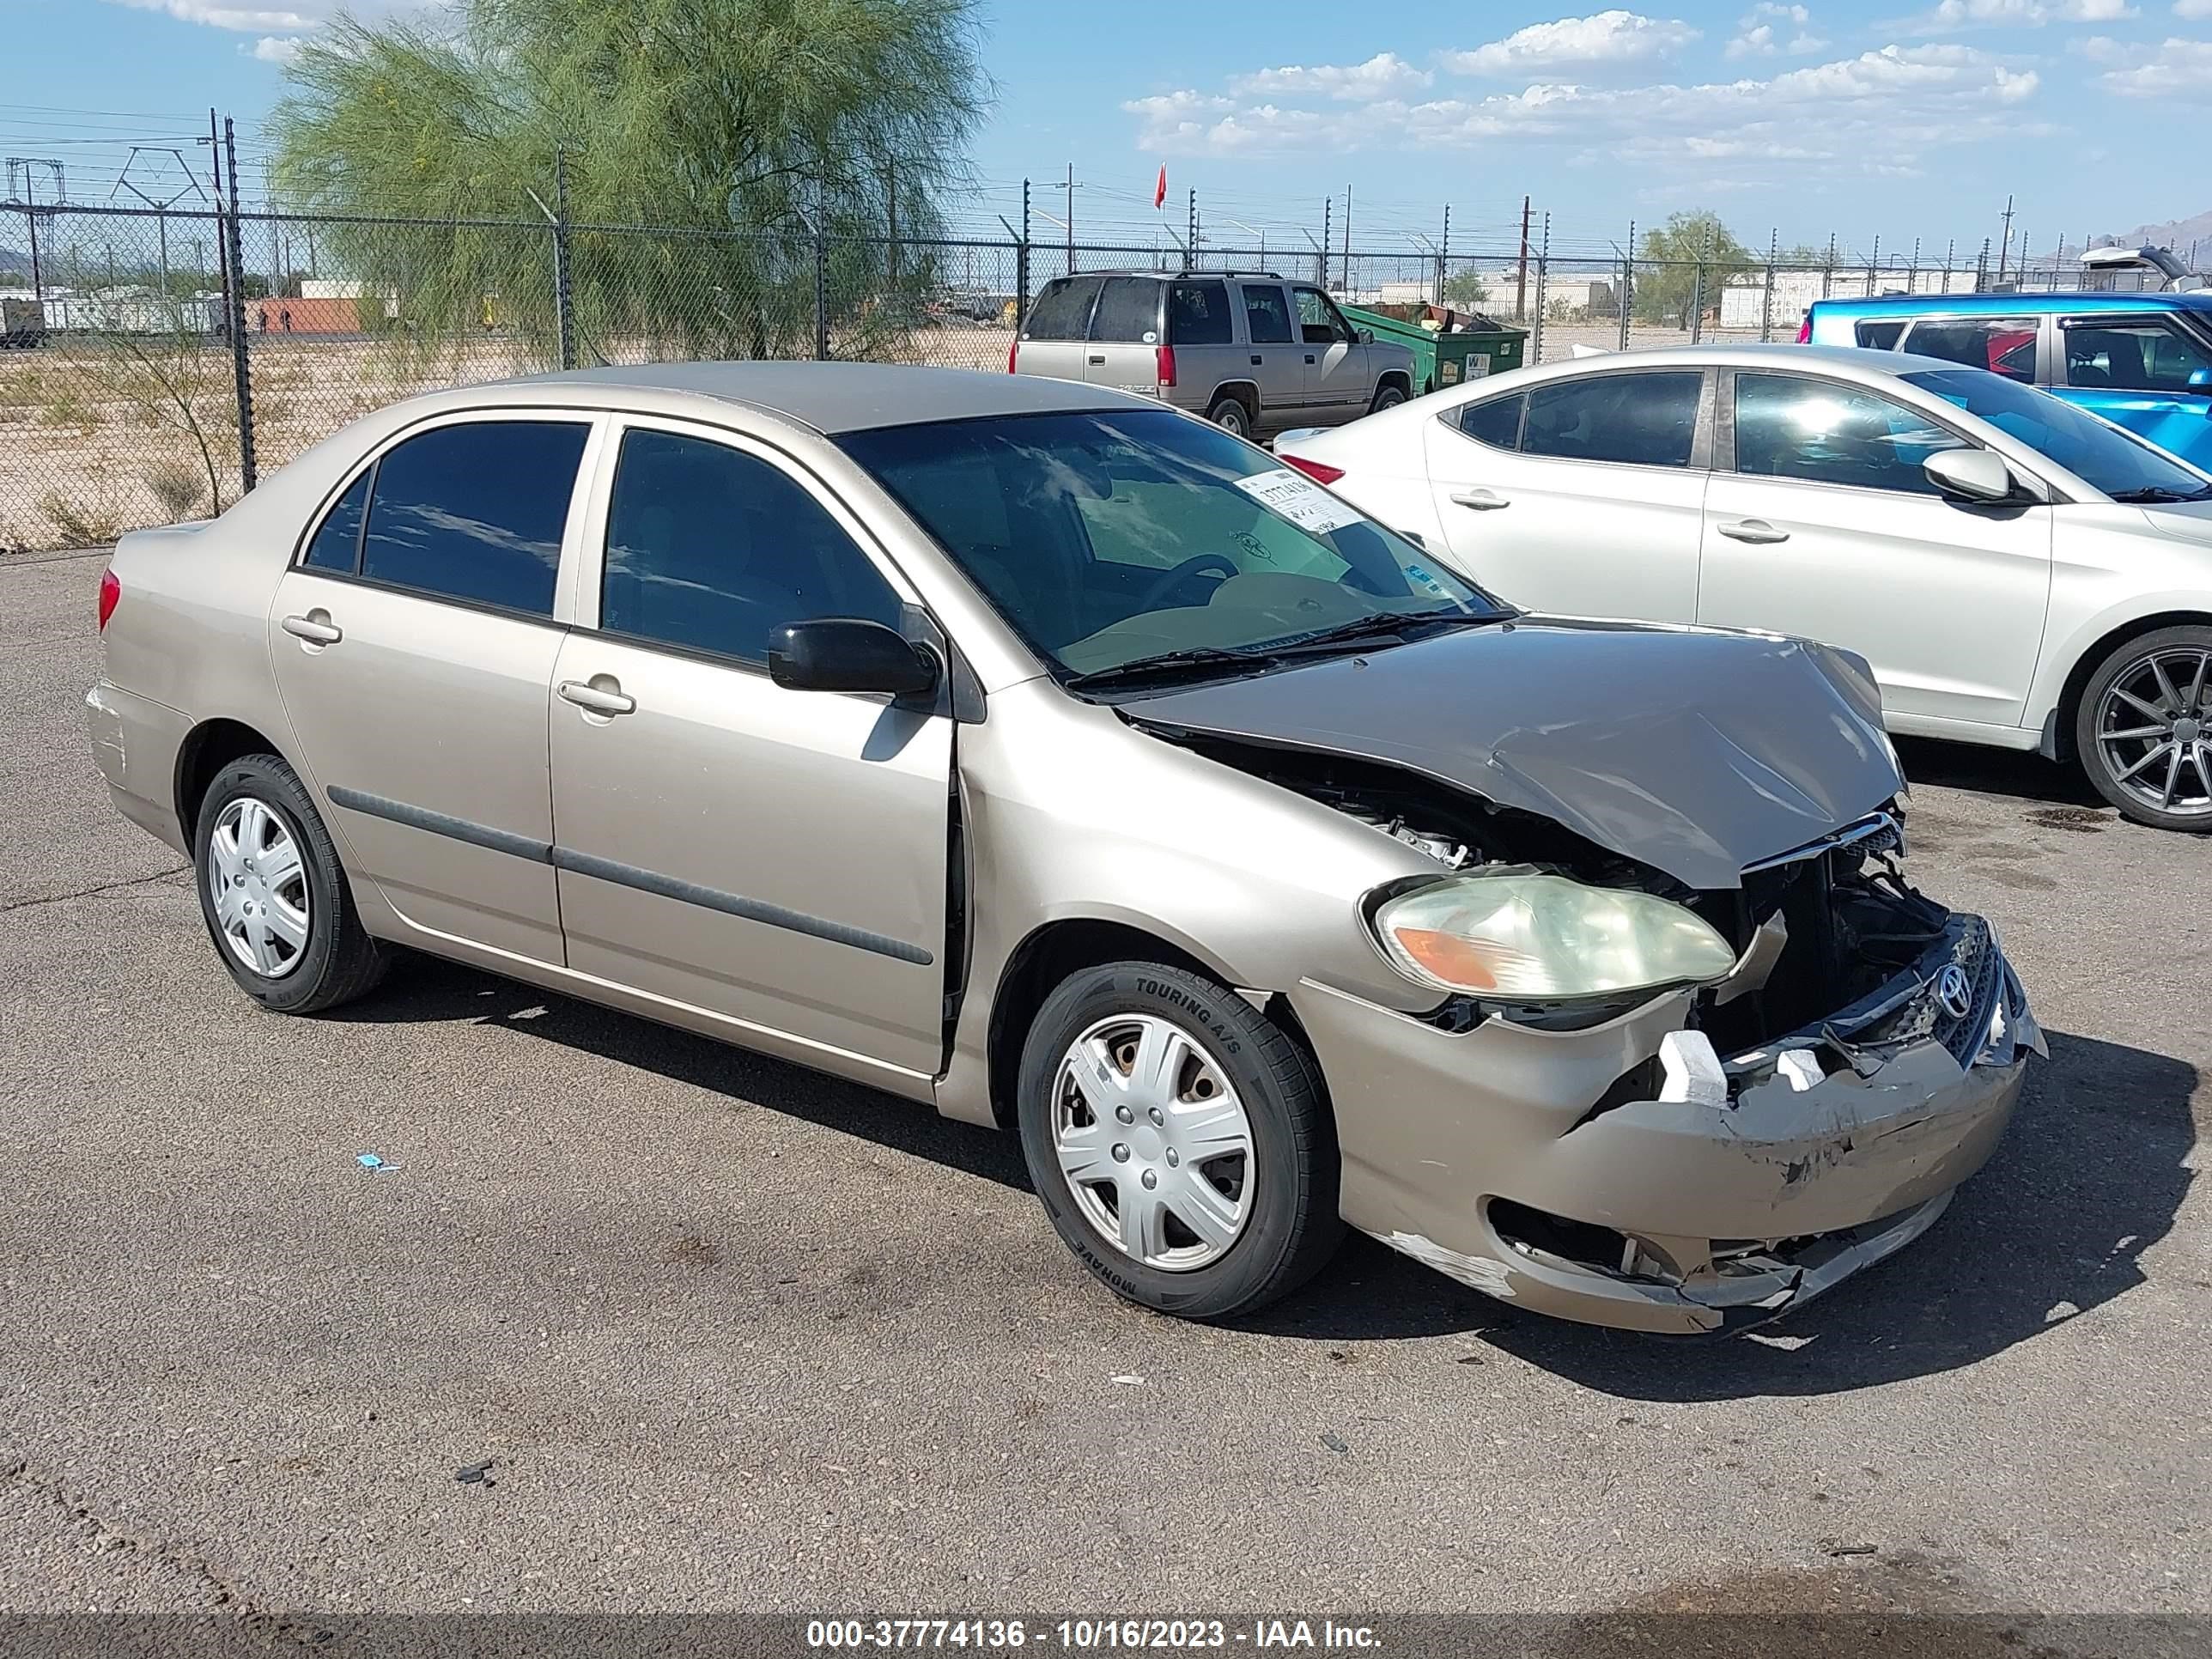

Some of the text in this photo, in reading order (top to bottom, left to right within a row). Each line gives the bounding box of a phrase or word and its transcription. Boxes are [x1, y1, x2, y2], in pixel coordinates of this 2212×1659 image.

[1259, 480, 1313, 502] 37774136
[1136, 978, 1241, 1054] TOURING A/S
[1073, 1242, 1136, 1295] MOHAVE
